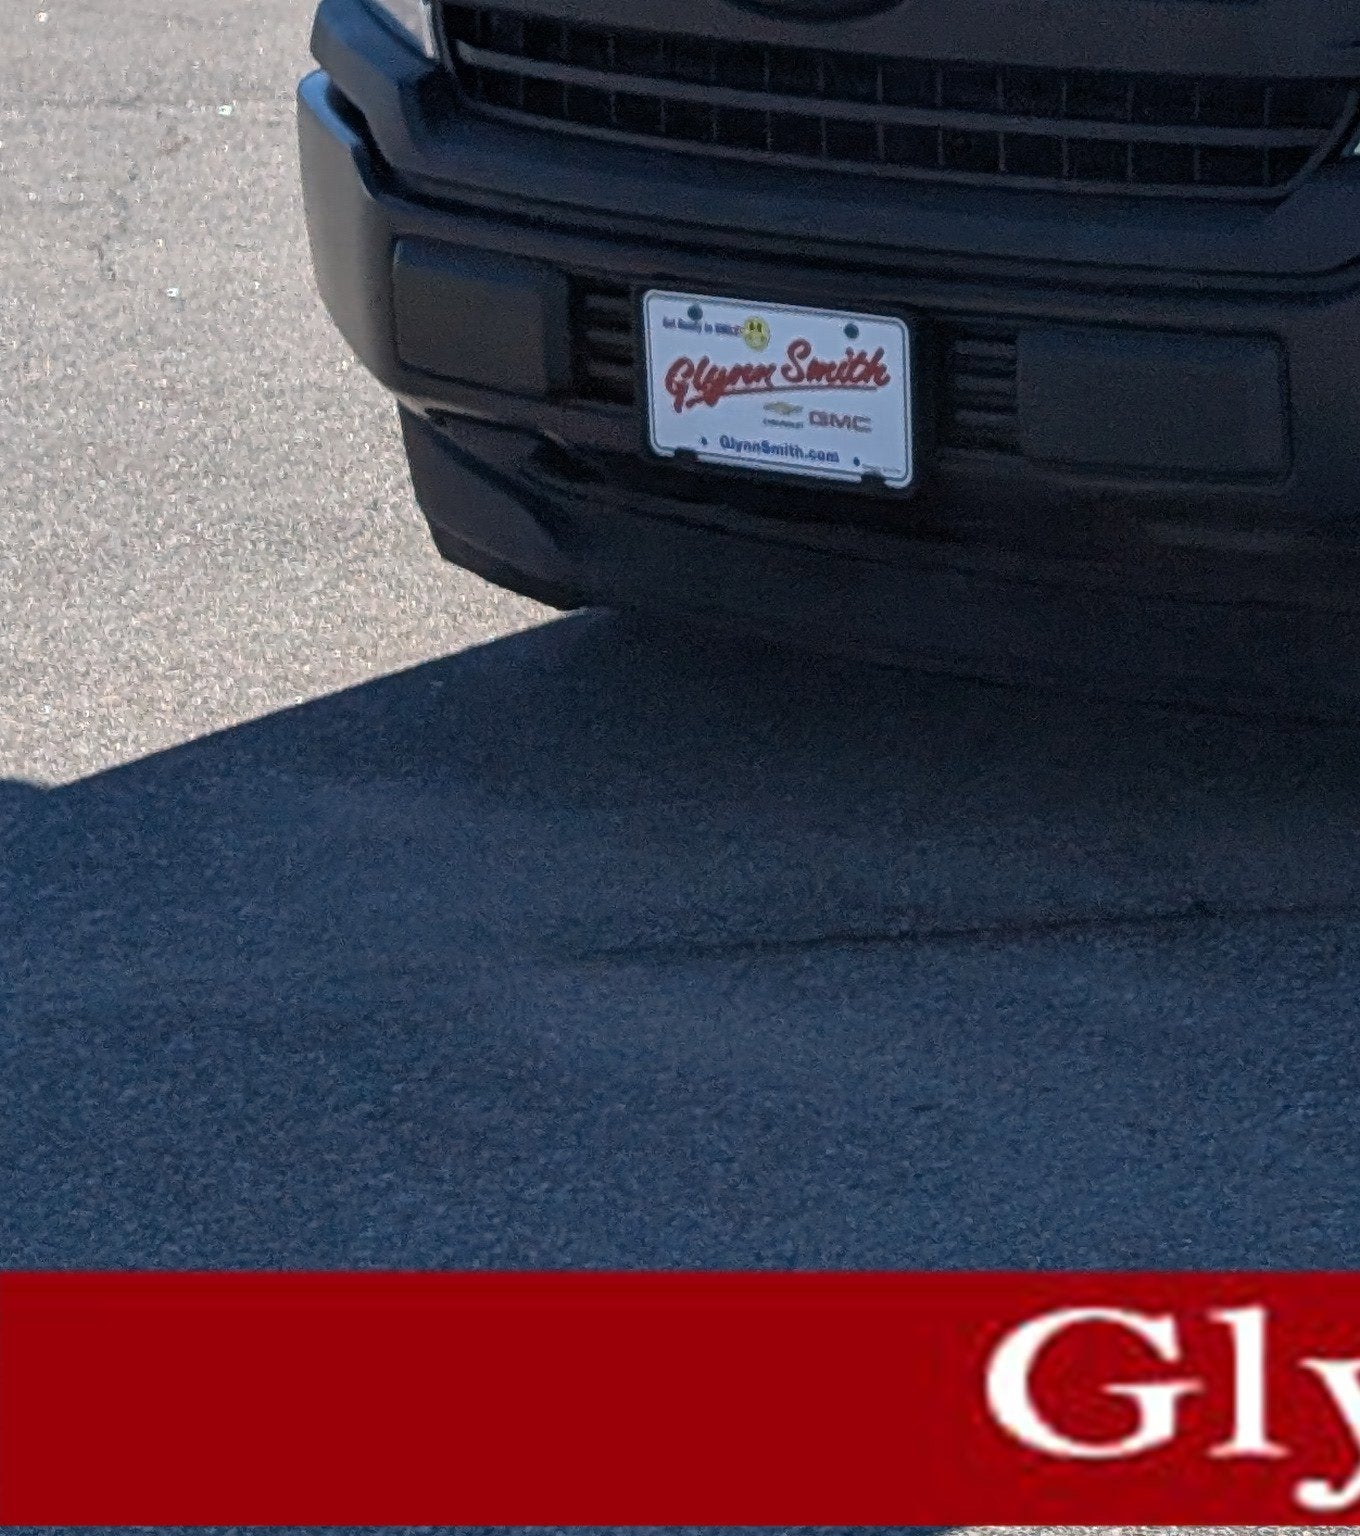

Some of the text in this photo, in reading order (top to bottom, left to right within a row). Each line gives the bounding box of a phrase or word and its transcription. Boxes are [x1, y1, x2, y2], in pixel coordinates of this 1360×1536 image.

[664, 338, 891, 413] Glynn Smith
[808, 410, 873, 433] GMC
[718, 433, 840, 463] GlynnSmith.com
